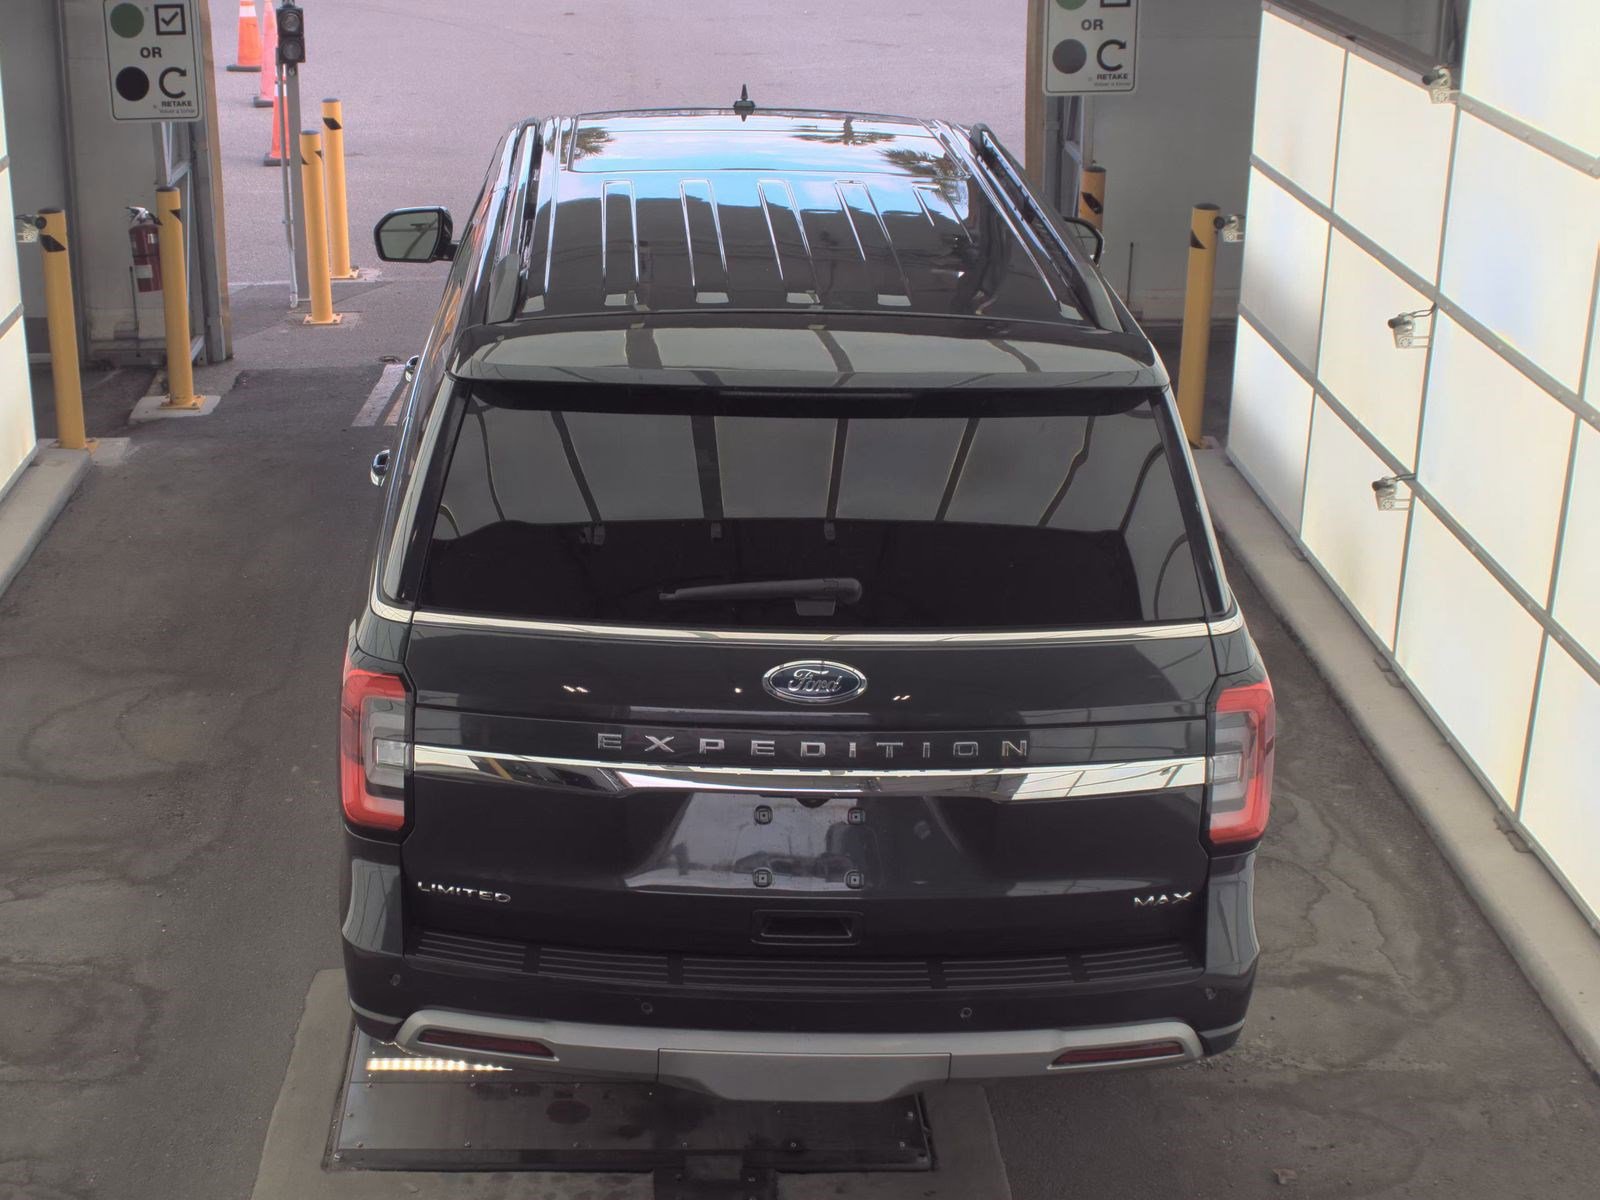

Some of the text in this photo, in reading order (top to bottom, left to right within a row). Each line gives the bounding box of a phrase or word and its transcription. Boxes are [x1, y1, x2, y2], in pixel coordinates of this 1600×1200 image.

[1081, 19, 1103, 31] OR
[140, 47, 162, 58] OR
[788, 669, 843, 692] Ford
[597, 732, 1028, 759] EXPEDITION
[417, 881, 511, 903] LIMITED
[1134, 892, 1192, 907] MAX
